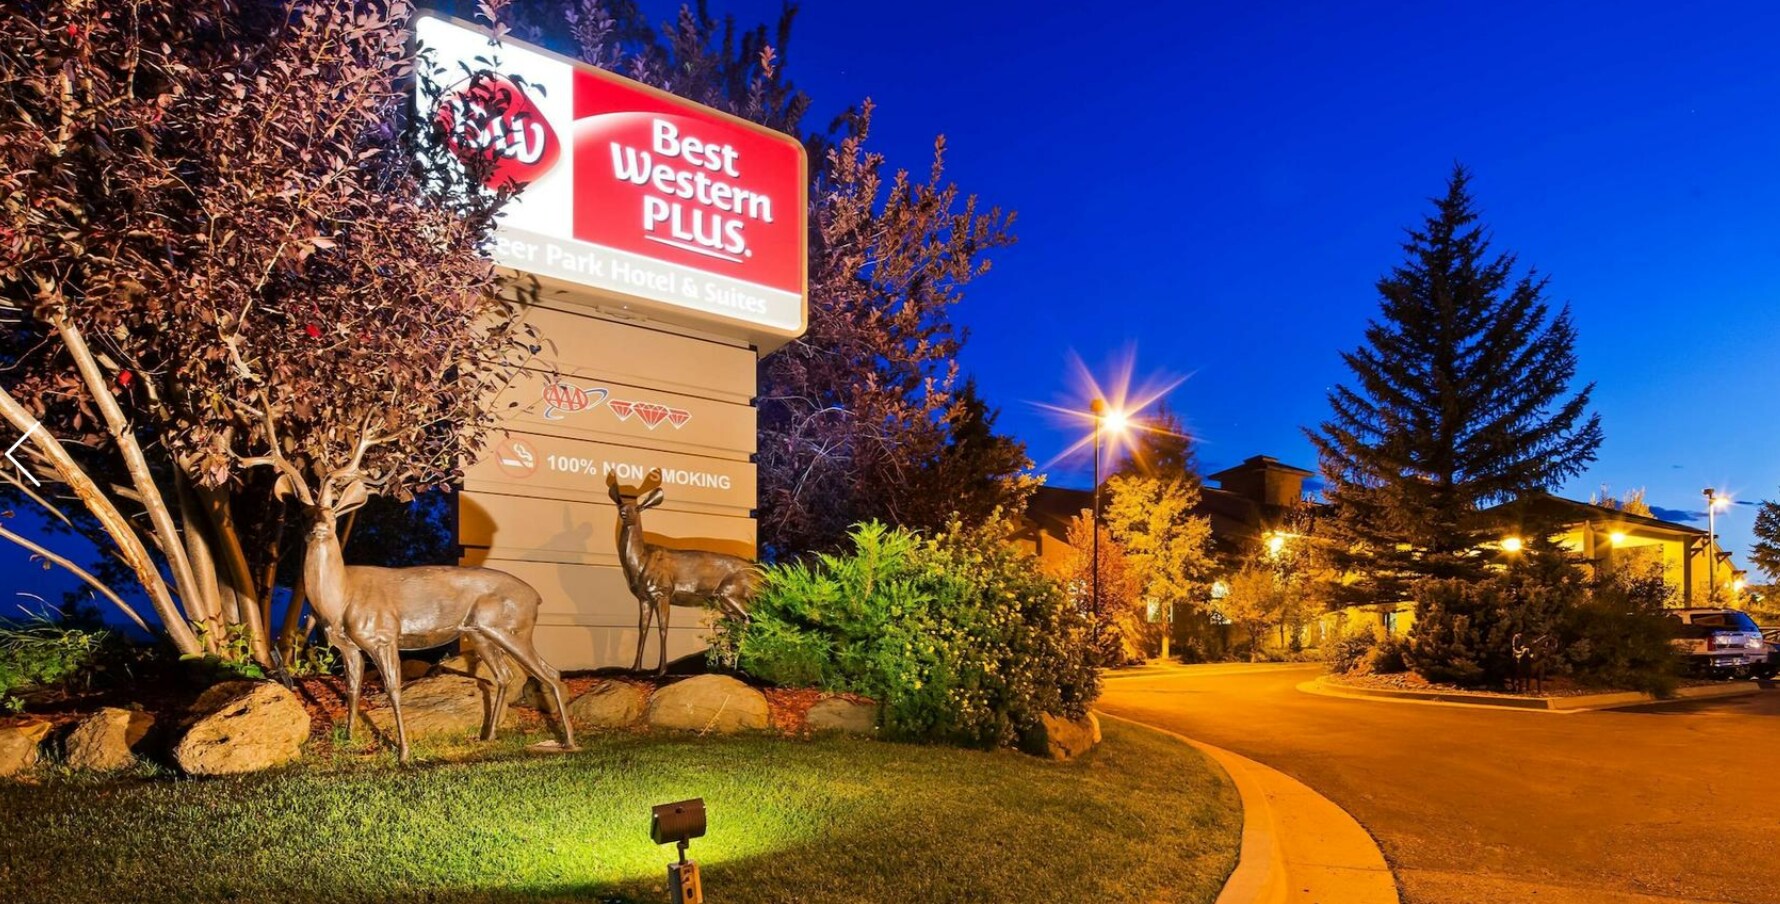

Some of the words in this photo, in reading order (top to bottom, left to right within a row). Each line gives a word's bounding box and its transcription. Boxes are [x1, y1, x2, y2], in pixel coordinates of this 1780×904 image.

[653, 118, 740, 178] Best
[610, 141, 774, 223] Western
[484, 236, 538, 262] eer
[546, 243, 604, 278] Park
[611, 258, 675, 294] Hotel
[681, 276, 699, 299] &
[704, 281, 768, 315] Suites
[547, 384, 586, 412] AAA
[547, 454, 597, 476] 100%
[603, 461, 643, 480] NON
[650, 467, 731, 490] SMOKING
